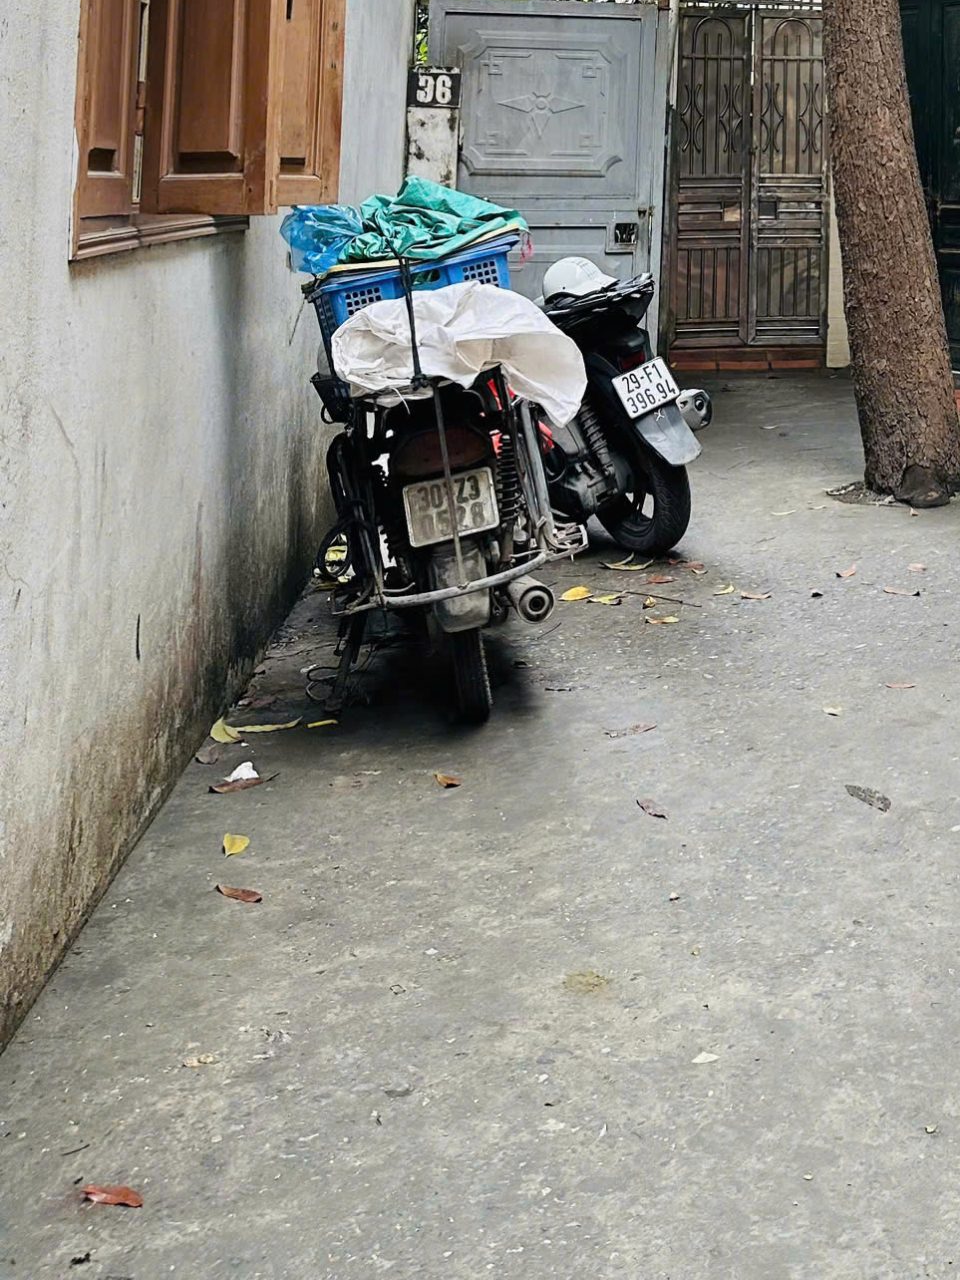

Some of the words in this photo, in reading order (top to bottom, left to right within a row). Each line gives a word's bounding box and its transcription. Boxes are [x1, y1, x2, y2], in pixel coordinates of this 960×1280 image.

[417, 75, 452, 104] 36
[622, 363, 662, 394] 29-F1
[627, 379, 676, 414] 396.94
